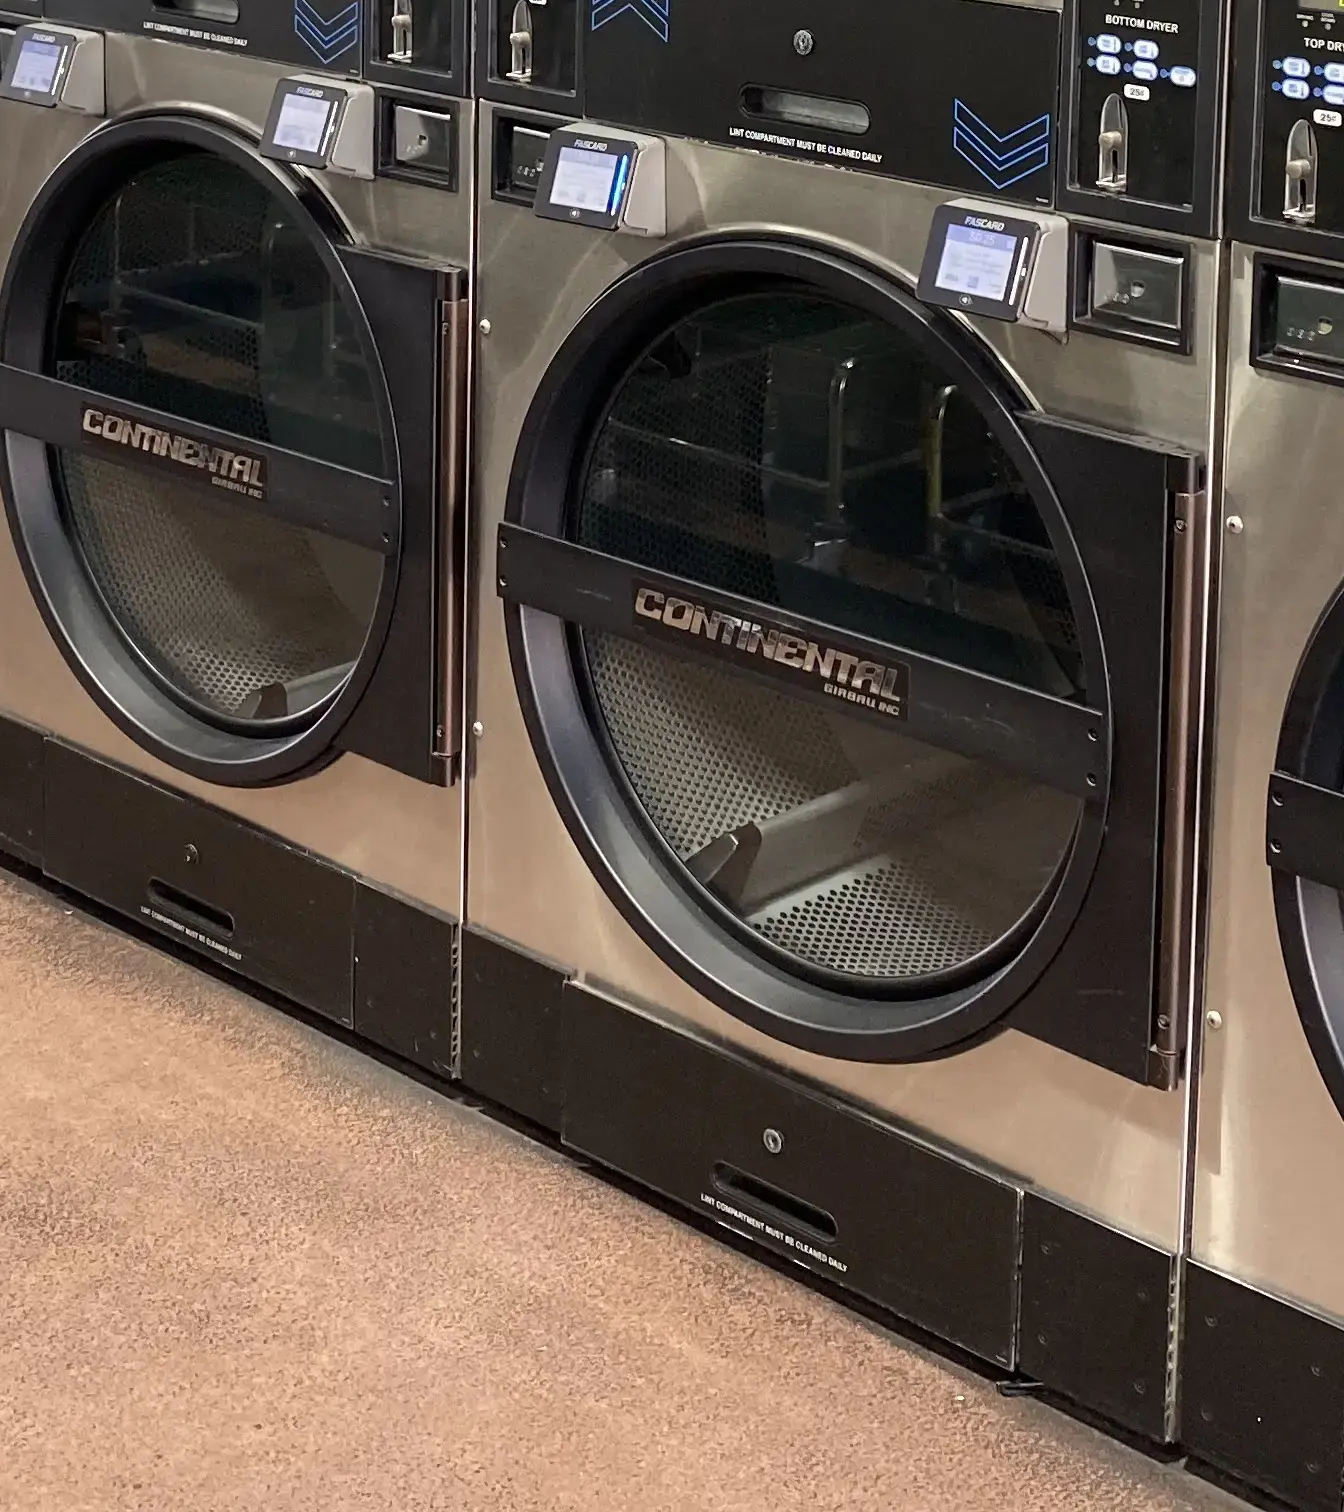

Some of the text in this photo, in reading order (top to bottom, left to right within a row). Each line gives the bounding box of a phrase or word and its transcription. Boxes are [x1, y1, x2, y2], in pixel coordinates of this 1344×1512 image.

[1105, 14, 1179, 34] BOTTOM DRYER
[1304, 37, 1325, 49] TOP
[745, 130, 795, 147] COMPARTMENT
[796, 140, 816, 151] MUST
[828, 145, 861, 160] CLEANED
[862, 151, 882, 163] DAILY
[965, 216, 1005, 231] FASCARD
[83, 409, 263, 487] CONTINENTAL
[635, 588, 900, 701] CONTINENTAL
[766, 1225, 784, 1240] MUST
[796, 1241, 827, 1263] CLEANED
[829, 1257, 848, 1272] DAILY
